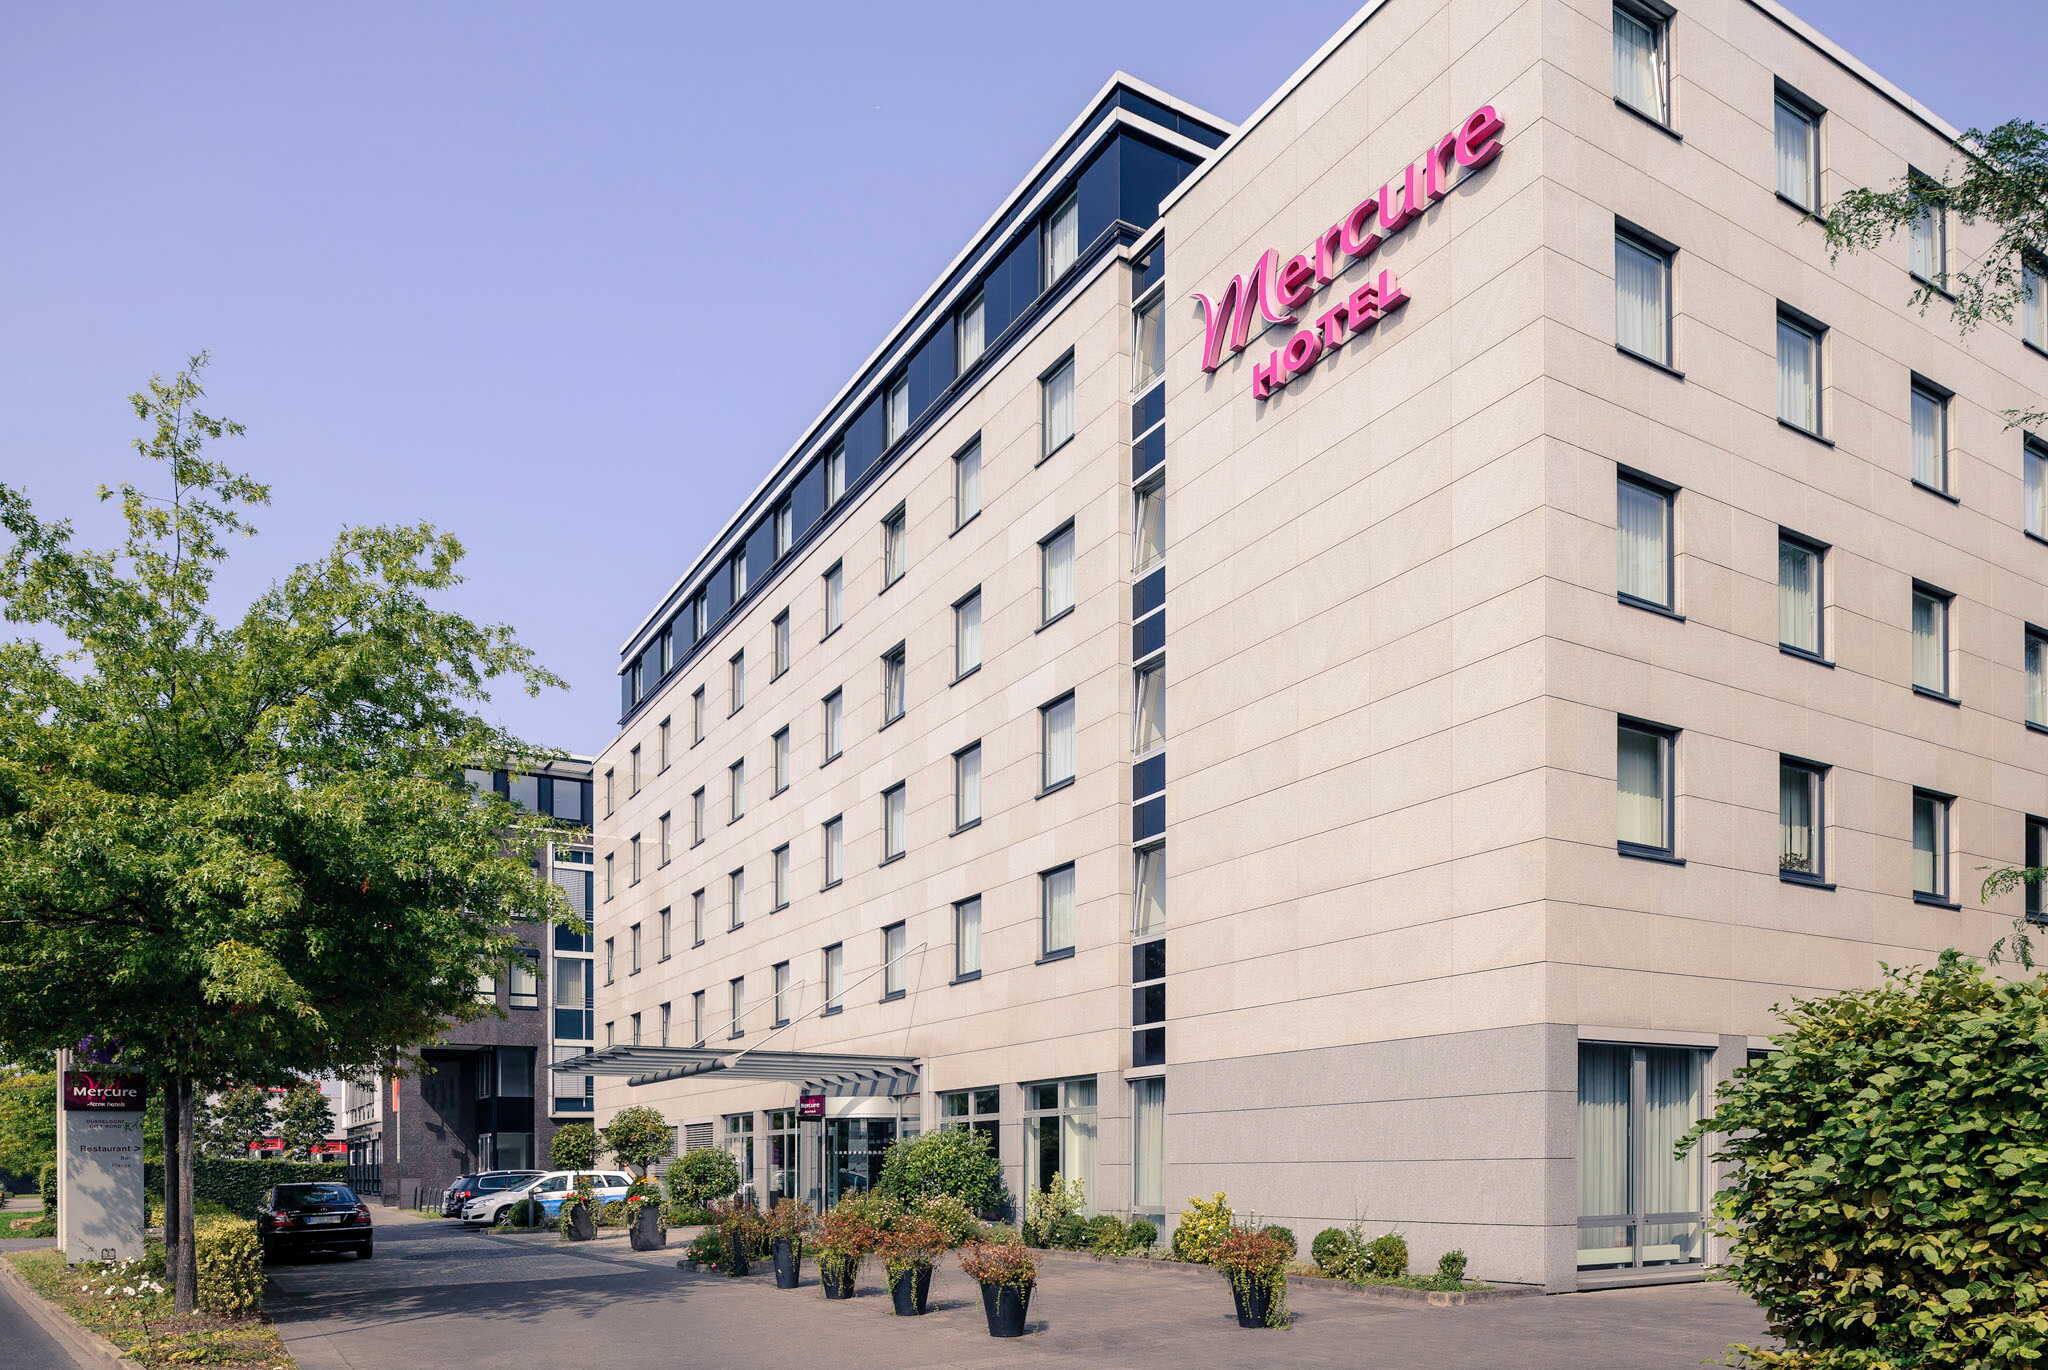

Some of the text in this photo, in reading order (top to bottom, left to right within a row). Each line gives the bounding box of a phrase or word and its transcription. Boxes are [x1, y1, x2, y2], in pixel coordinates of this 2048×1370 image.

[1191, 105, 1505, 373] Mercure
[1253, 269, 1411, 400] HOTEL
[73, 1086, 137, 1097] Mercure
